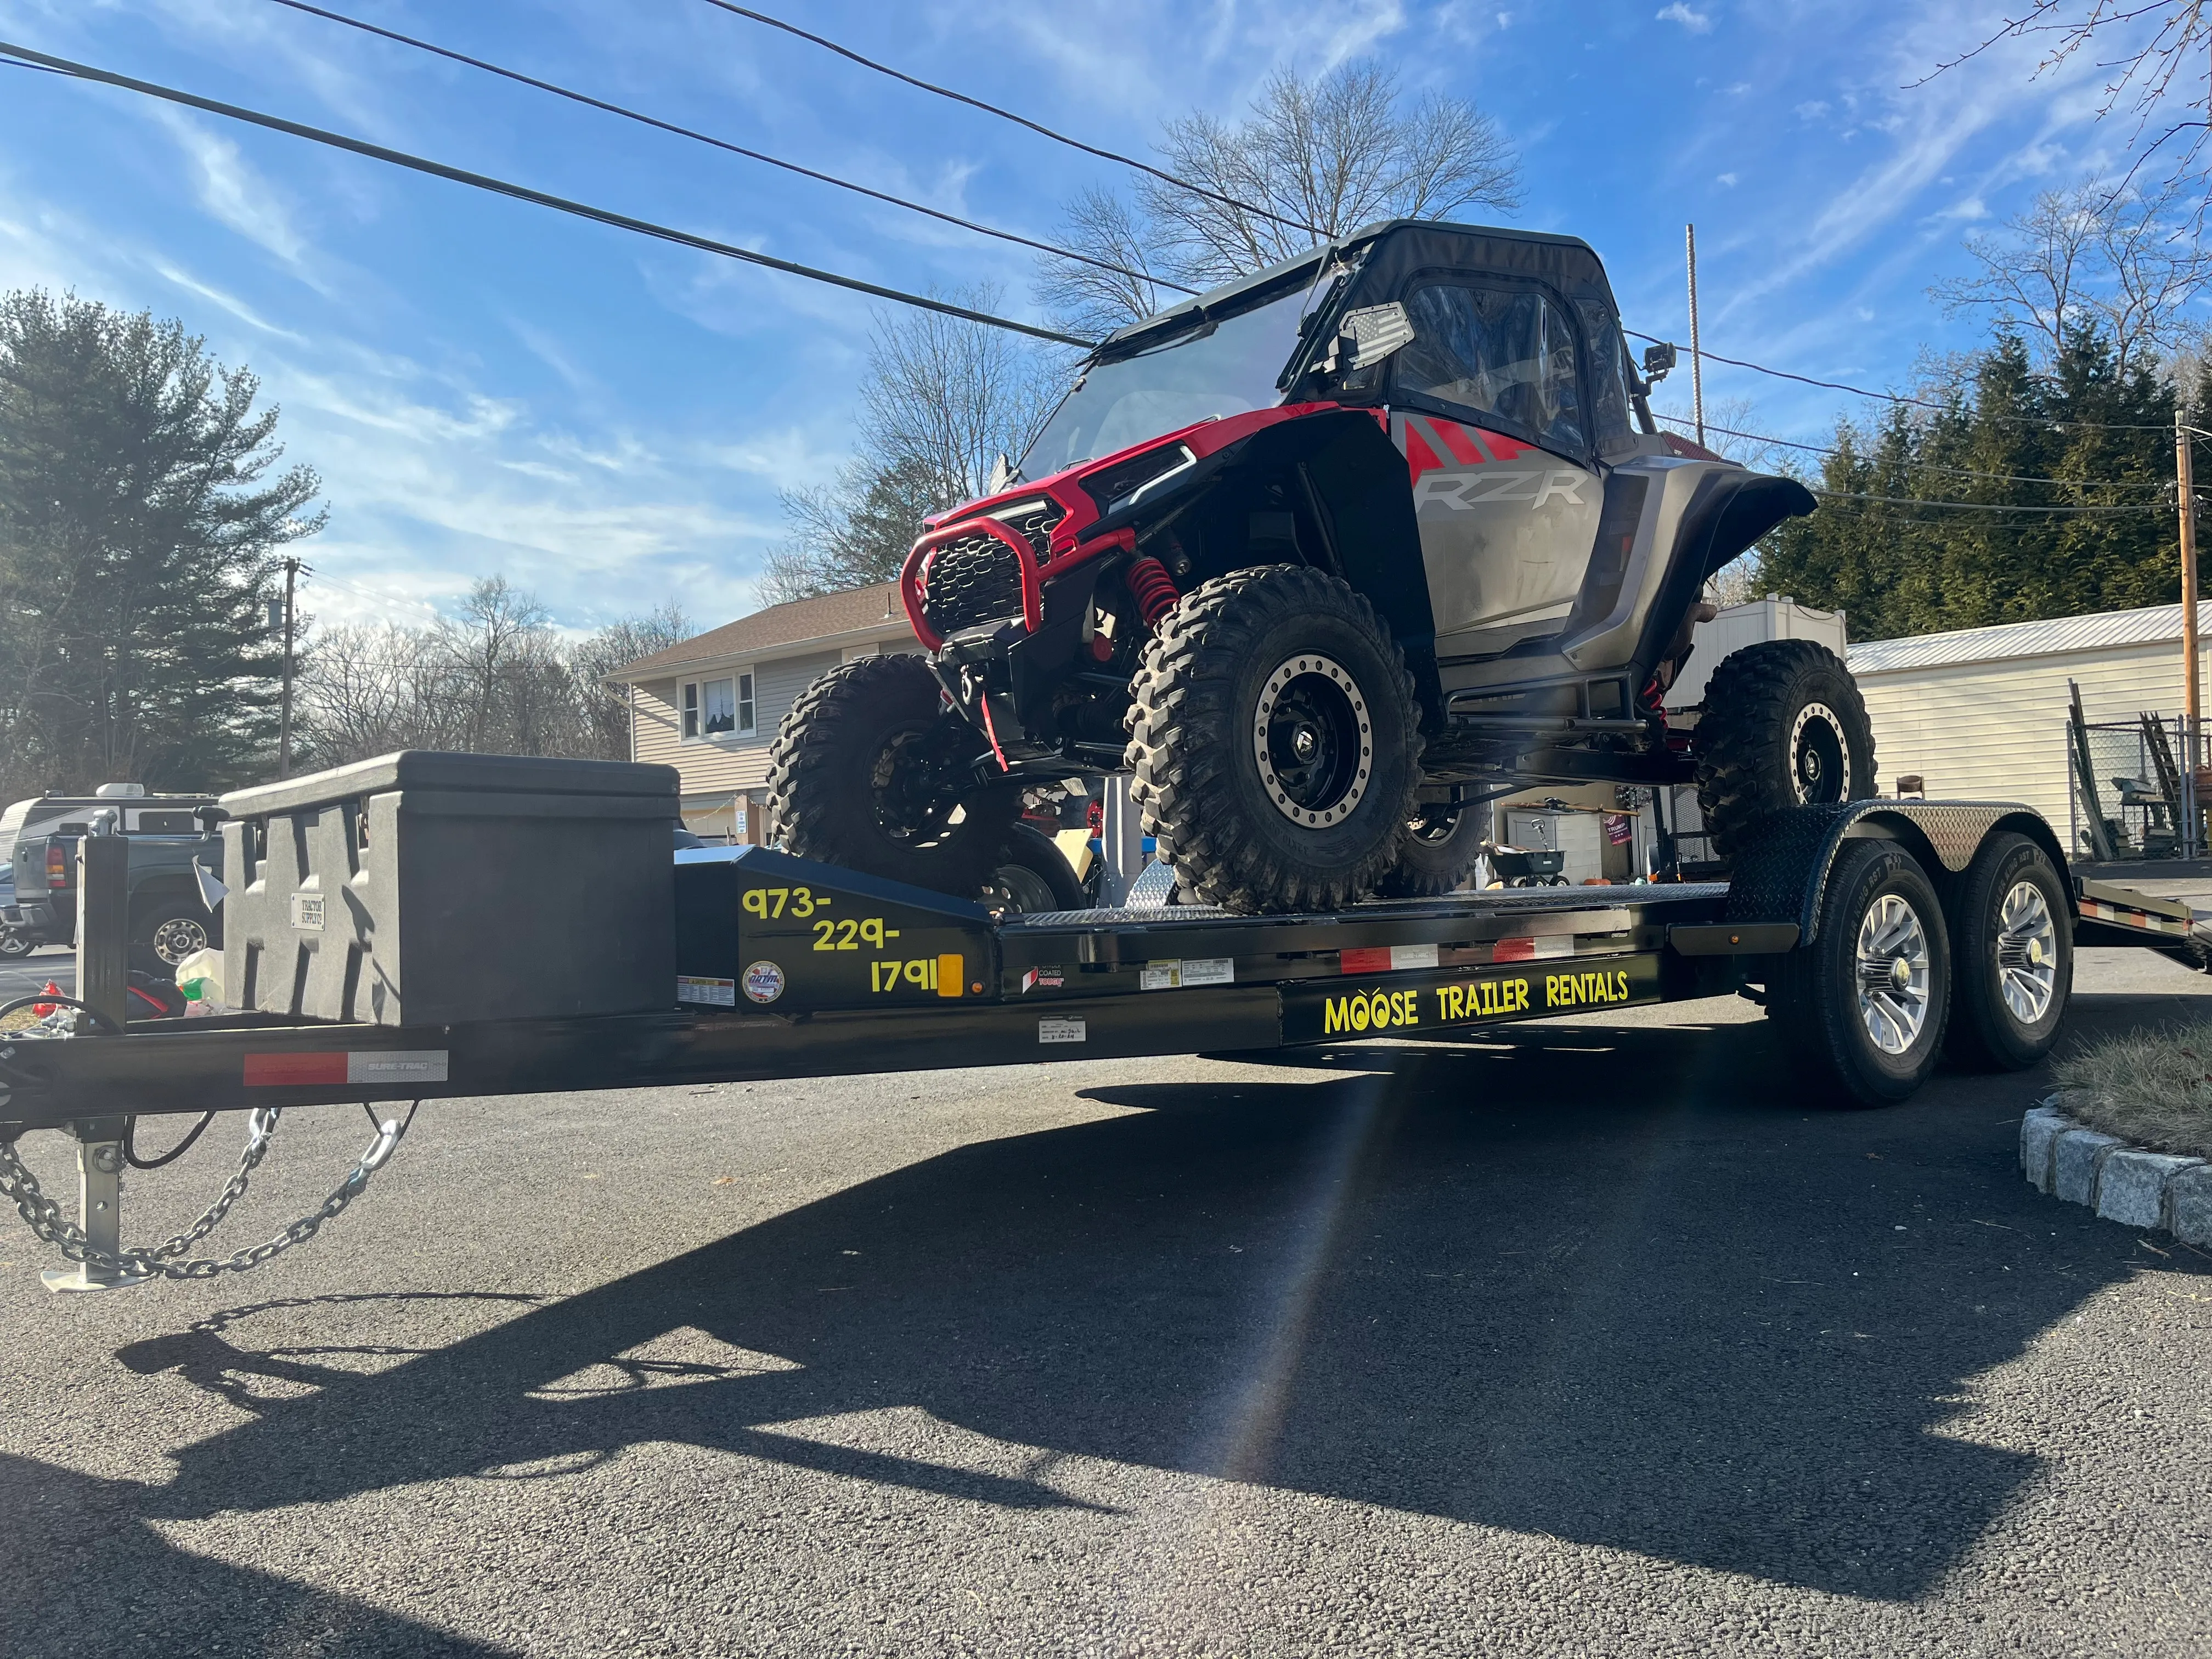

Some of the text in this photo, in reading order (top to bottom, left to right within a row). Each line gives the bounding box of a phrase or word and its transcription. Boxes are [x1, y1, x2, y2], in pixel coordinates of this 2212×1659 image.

[1413, 469, 1589, 514] RZR
[1607, 822, 1626, 832] TRUMP
[2004, 857, 2018, 881] KING
[2019, 850, 2030, 864] RST
[302, 899, 322, 912] TRACTOR
[742, 887, 831, 919] 973-
[1853, 884, 1870, 918] KING
[1867, 866, 1882, 888] RST
[302, 912, 317, 924] SUPPLY
[813, 918, 900, 951] 229-
[871, 958, 938, 992] 1791
[1324, 970, 1629, 1034] MOOSE TRAILER RENTALS
[368, 1062, 428, 1070] SURE-TRAC
